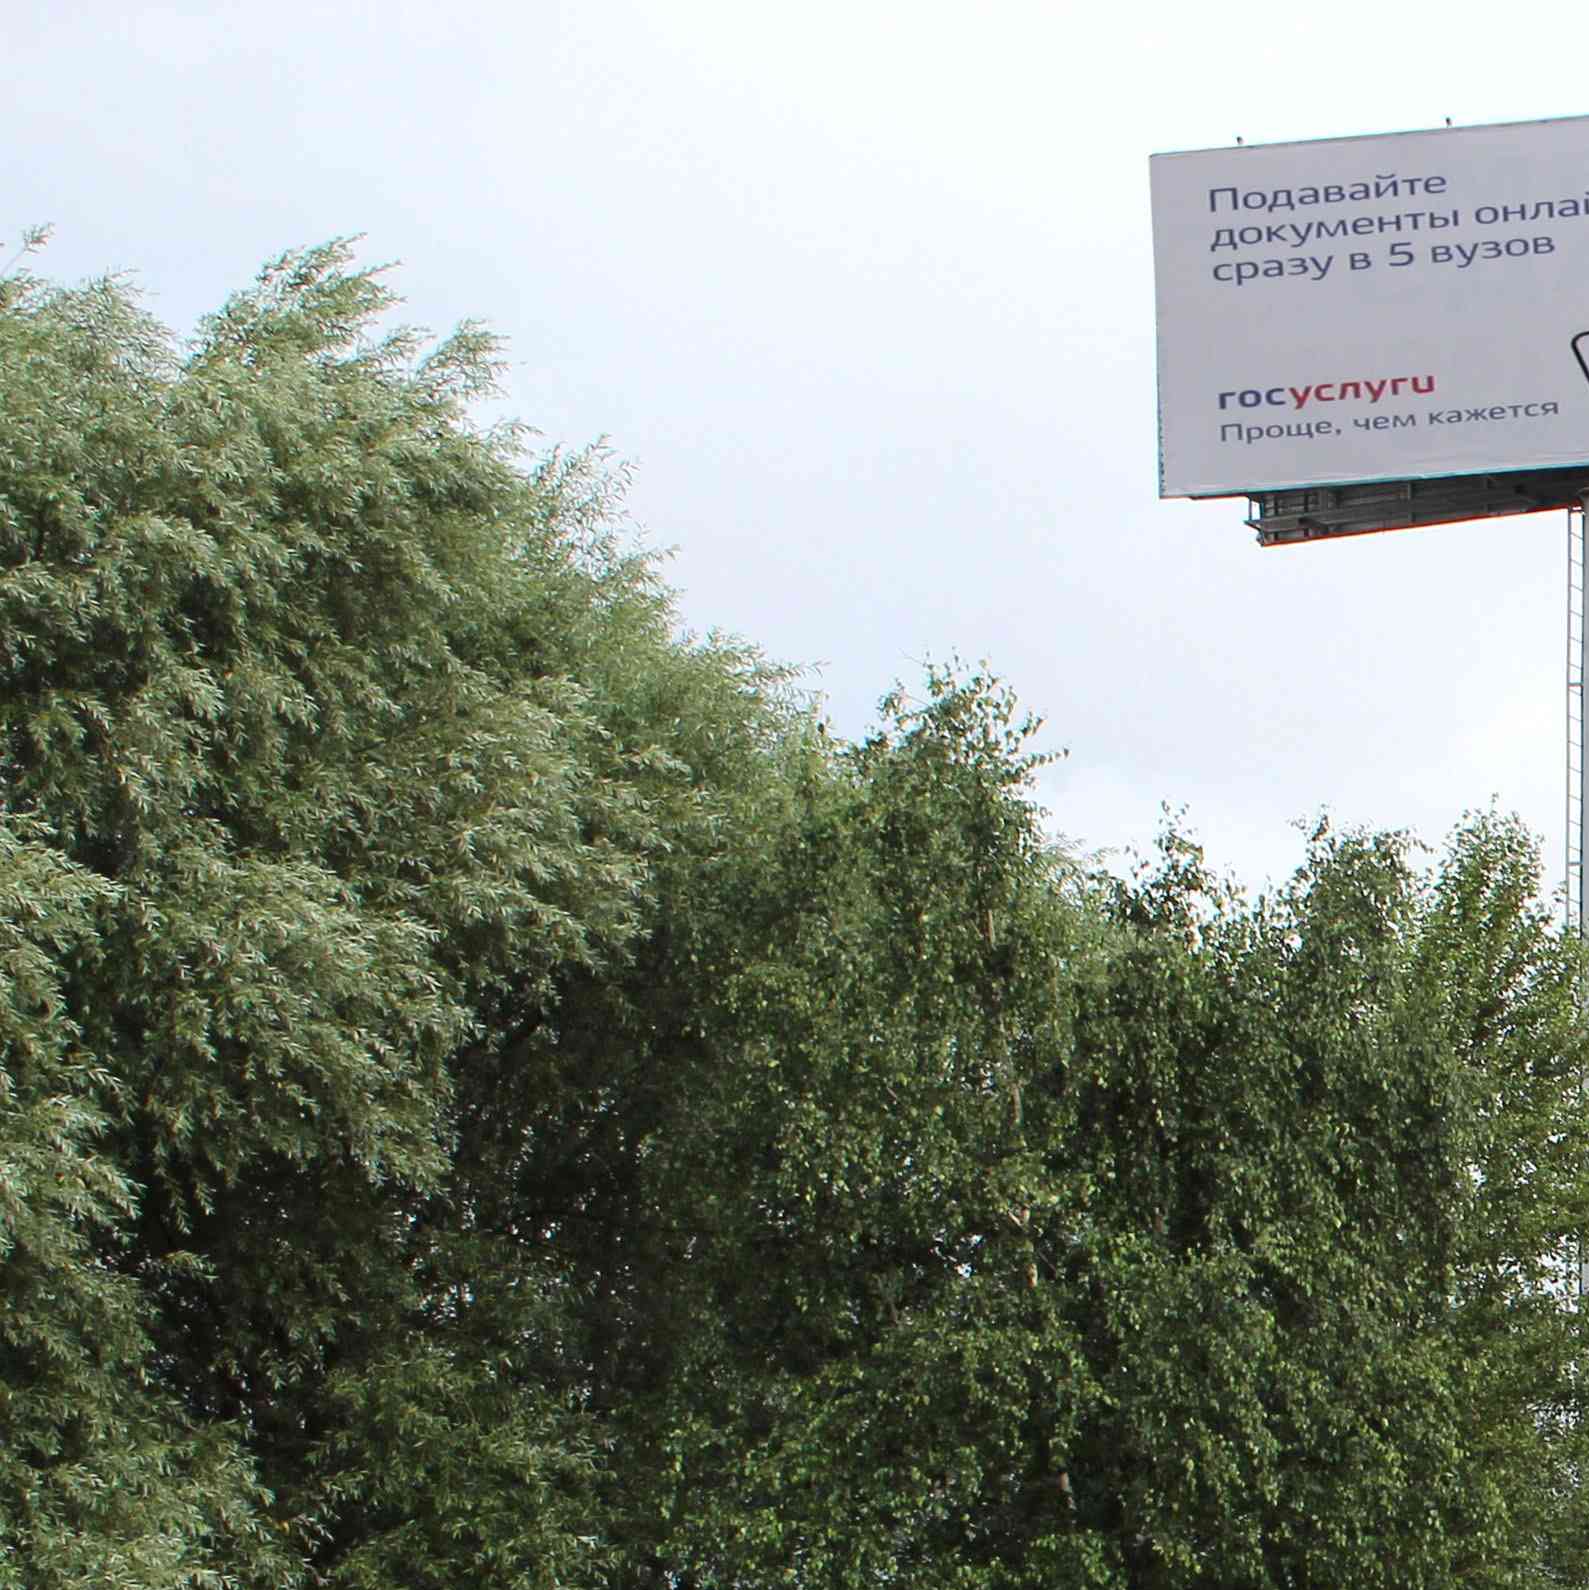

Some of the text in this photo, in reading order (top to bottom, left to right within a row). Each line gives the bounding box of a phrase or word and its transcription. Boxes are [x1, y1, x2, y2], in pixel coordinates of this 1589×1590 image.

[1209, 173, 1448, 213] Подавайте
[1210, 208, 1460, 252] документы
[1212, 235, 1556, 286] сразу в 5 вузов
[1218, 374, 1436, 410] госуслуги
[1220, 400, 1561, 445] Проще, чем кажется
